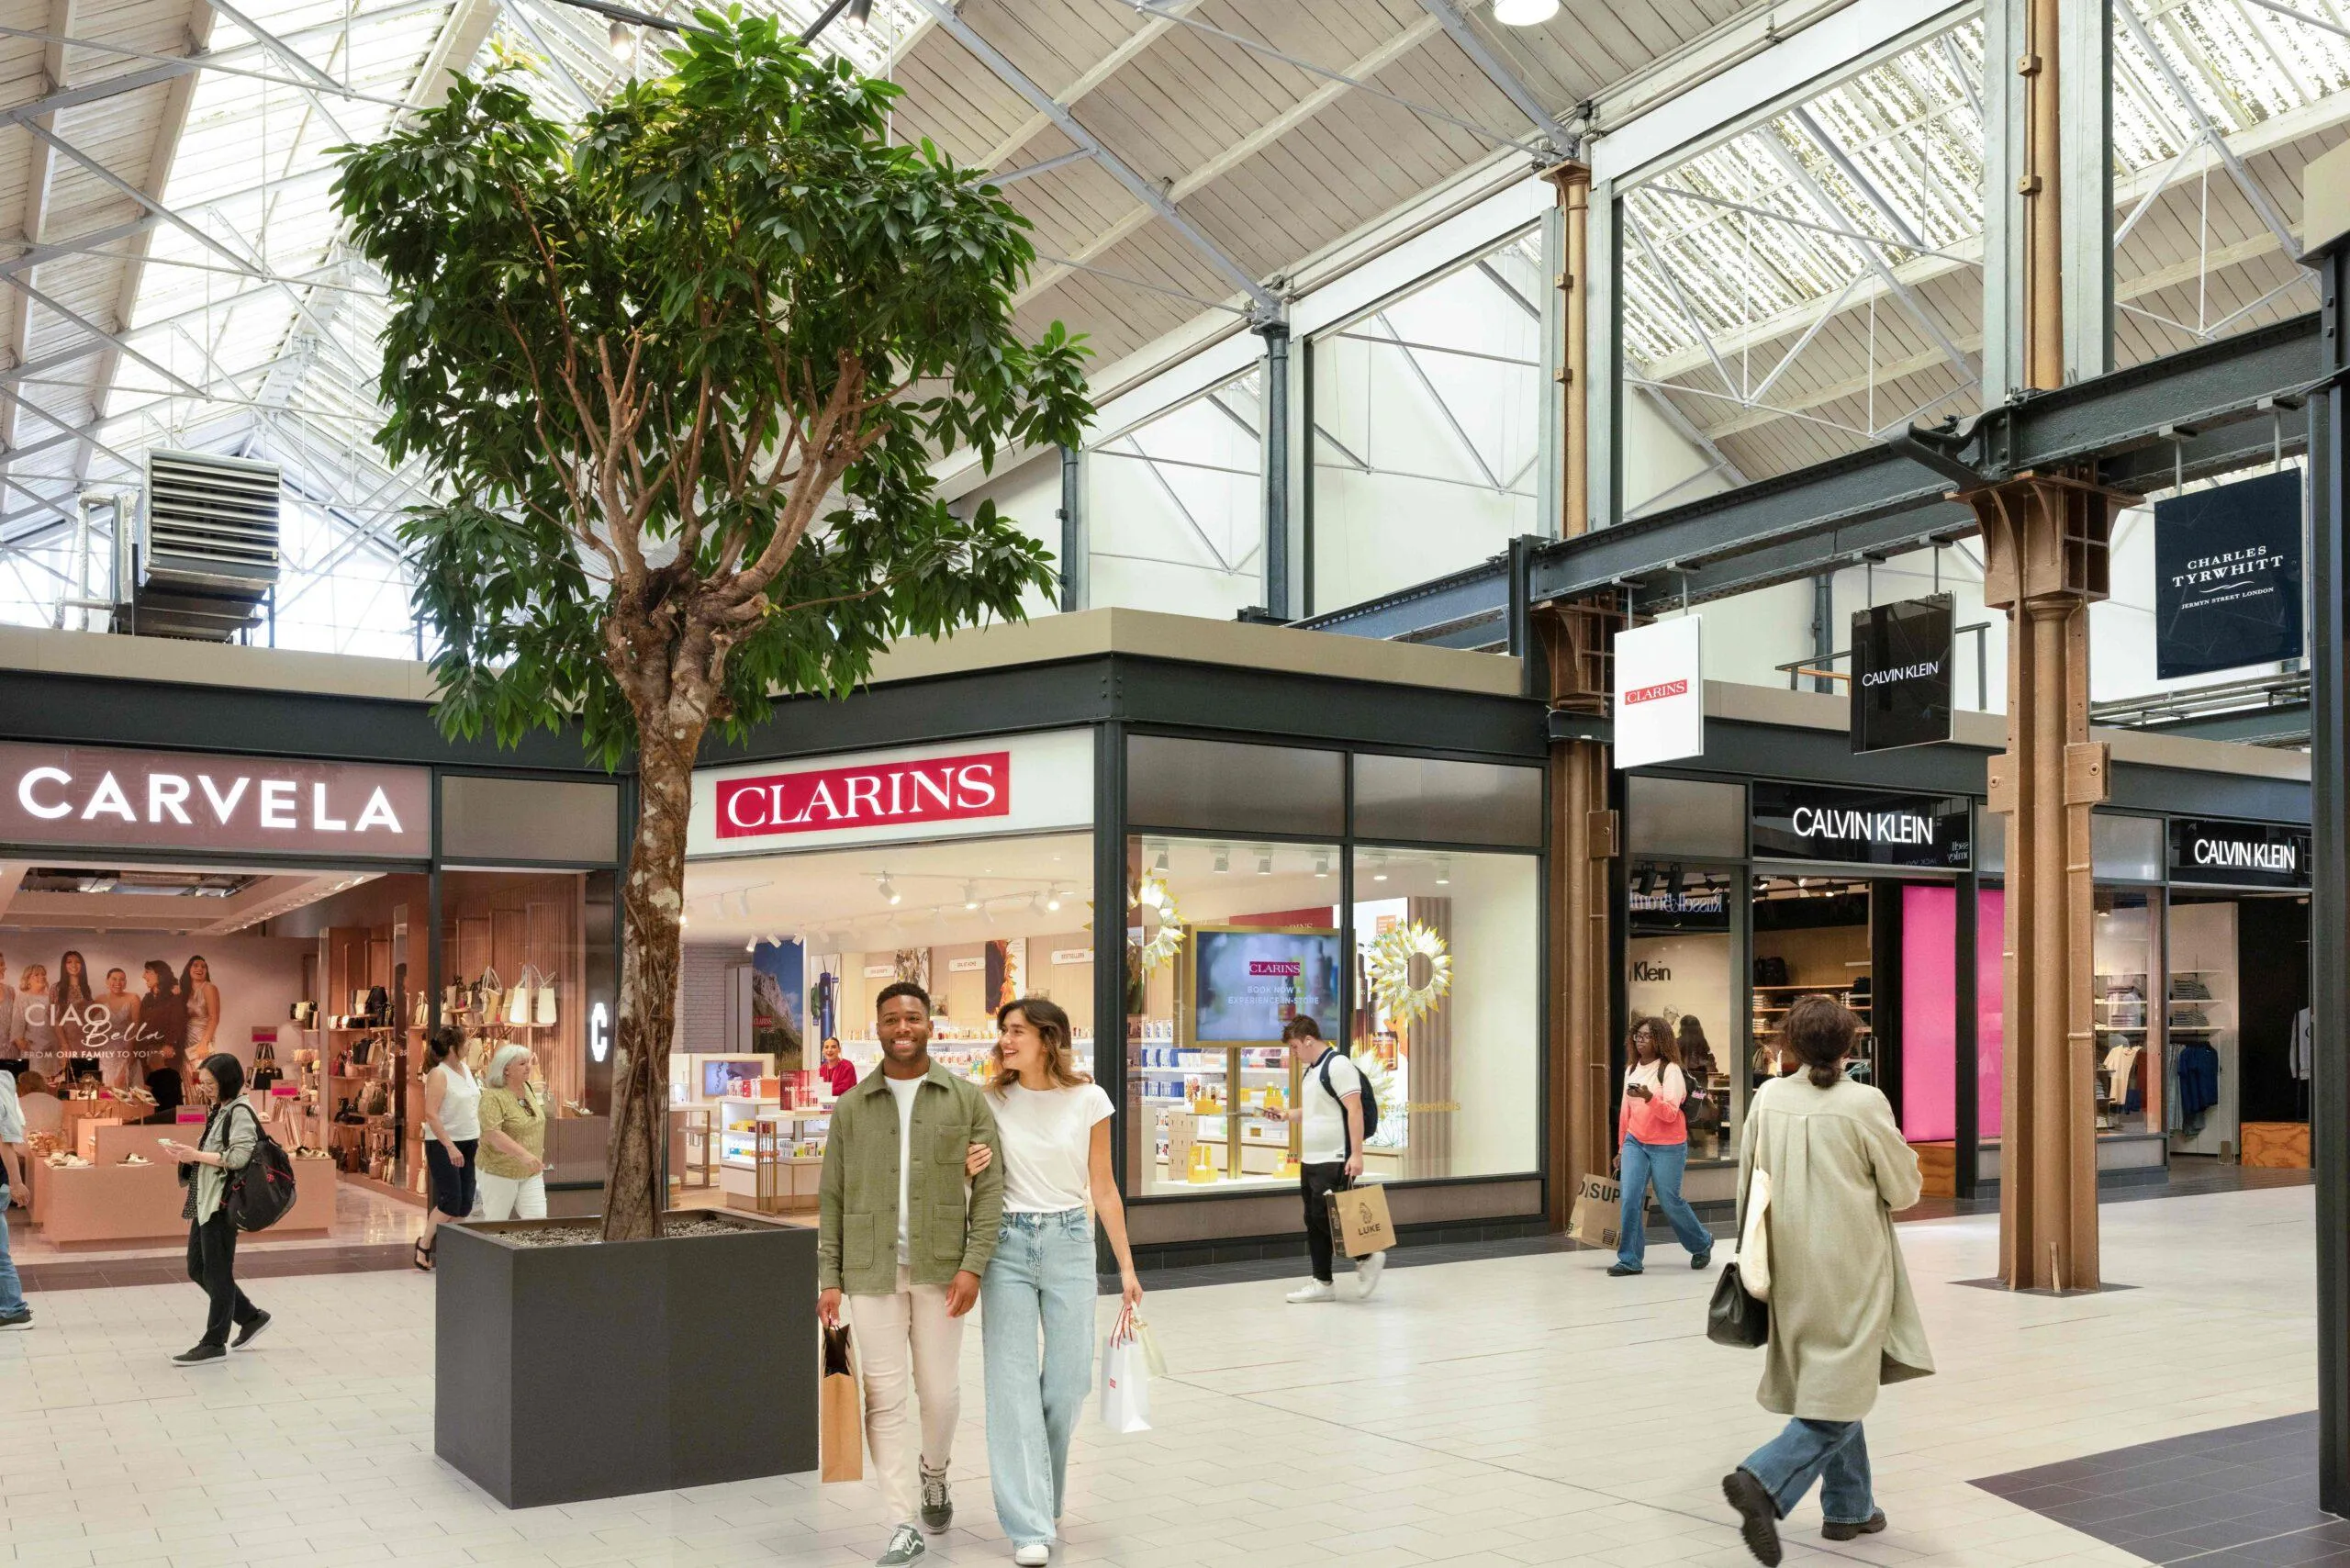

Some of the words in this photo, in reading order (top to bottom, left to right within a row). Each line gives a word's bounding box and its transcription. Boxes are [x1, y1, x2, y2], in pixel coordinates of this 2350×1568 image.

[2187, 545, 2267, 570] CHARLES
[2172, 554, 2284, 588] TYRWHITT
[2181, 599, 2210, 610] JERMYN
[2211, 593, 2241, 604] STREET
[2242, 587, 2275, 598] LONDON
[1862, 666, 1904, 687] CALVIN
[1906, 660, 1939, 679] KLEIN
[1627, 681, 1685, 703] CLARINS
[17, 766, 404, 834] CARVELA
[727, 764, 996, 828] CLARINS
[1792, 806, 1873, 841] CALVIN
[1876, 812, 1934, 846] KLEIN
[2194, 837, 2252, 867] CALVIN
[2254, 843, 2296, 870] KLEIN
[1249, 963, 1301, 975] CLARINS
[1633, 960, 1672, 982] Klein
[1227, 995, 1281, 1005] EXPERIENCE
[1248, 985, 1271, 994] BOOK
[1273, 985, 1294, 994] NOW
[24, 1003, 111, 1027] CIAO
[81, 1019, 164, 1047] Bella
[590, 1002, 608, 1062] C
[23, 1050, 52, 1058] FROM
[55, 1050, 78, 1058] OUR
[81, 1050, 115, 1058] FAMILY
[117, 1050, 129, 1058] TO
[1358, 1223, 1381, 1236] LUKE
